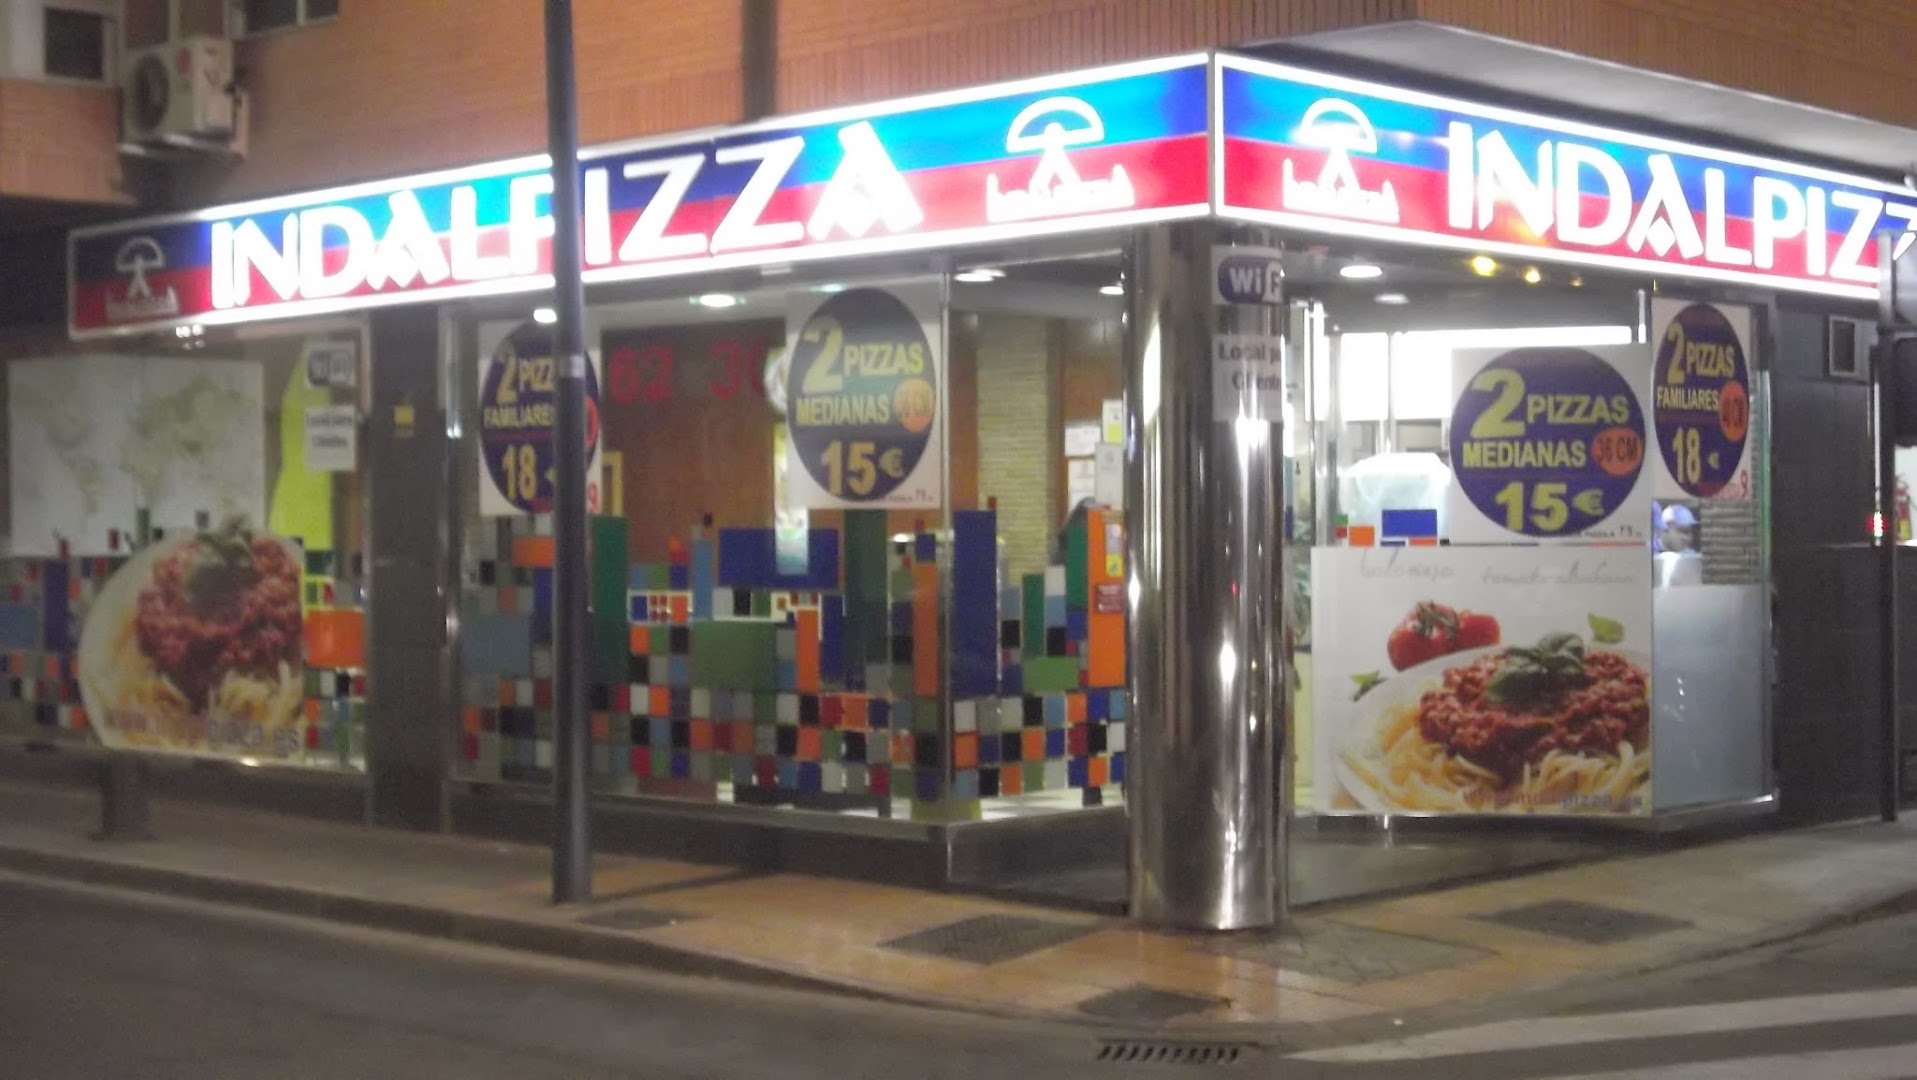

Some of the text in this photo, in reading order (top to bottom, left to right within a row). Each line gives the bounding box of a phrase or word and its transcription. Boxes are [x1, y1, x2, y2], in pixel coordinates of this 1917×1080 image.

[211, 120, 923, 309] INDALPIZZA
[1448, 119, 1917, 283] INDALPIZZ
[518, 357, 556, 393] PIZZ
[802, 315, 924, 395] 2 PIZZAS
[1666, 322, 1736, 384] 2 PIZZAS
[483, 402, 556, 429] FAMILIARE
[796, 393, 891, 426] MEDIANAS
[1470, 368, 1631, 439] 2 PIZZAS
[1656, 385, 1719, 412] FAMILIARES
[1462, 439, 1587, 469] MEDIANAS
[1672, 426, 1701, 484] 18
